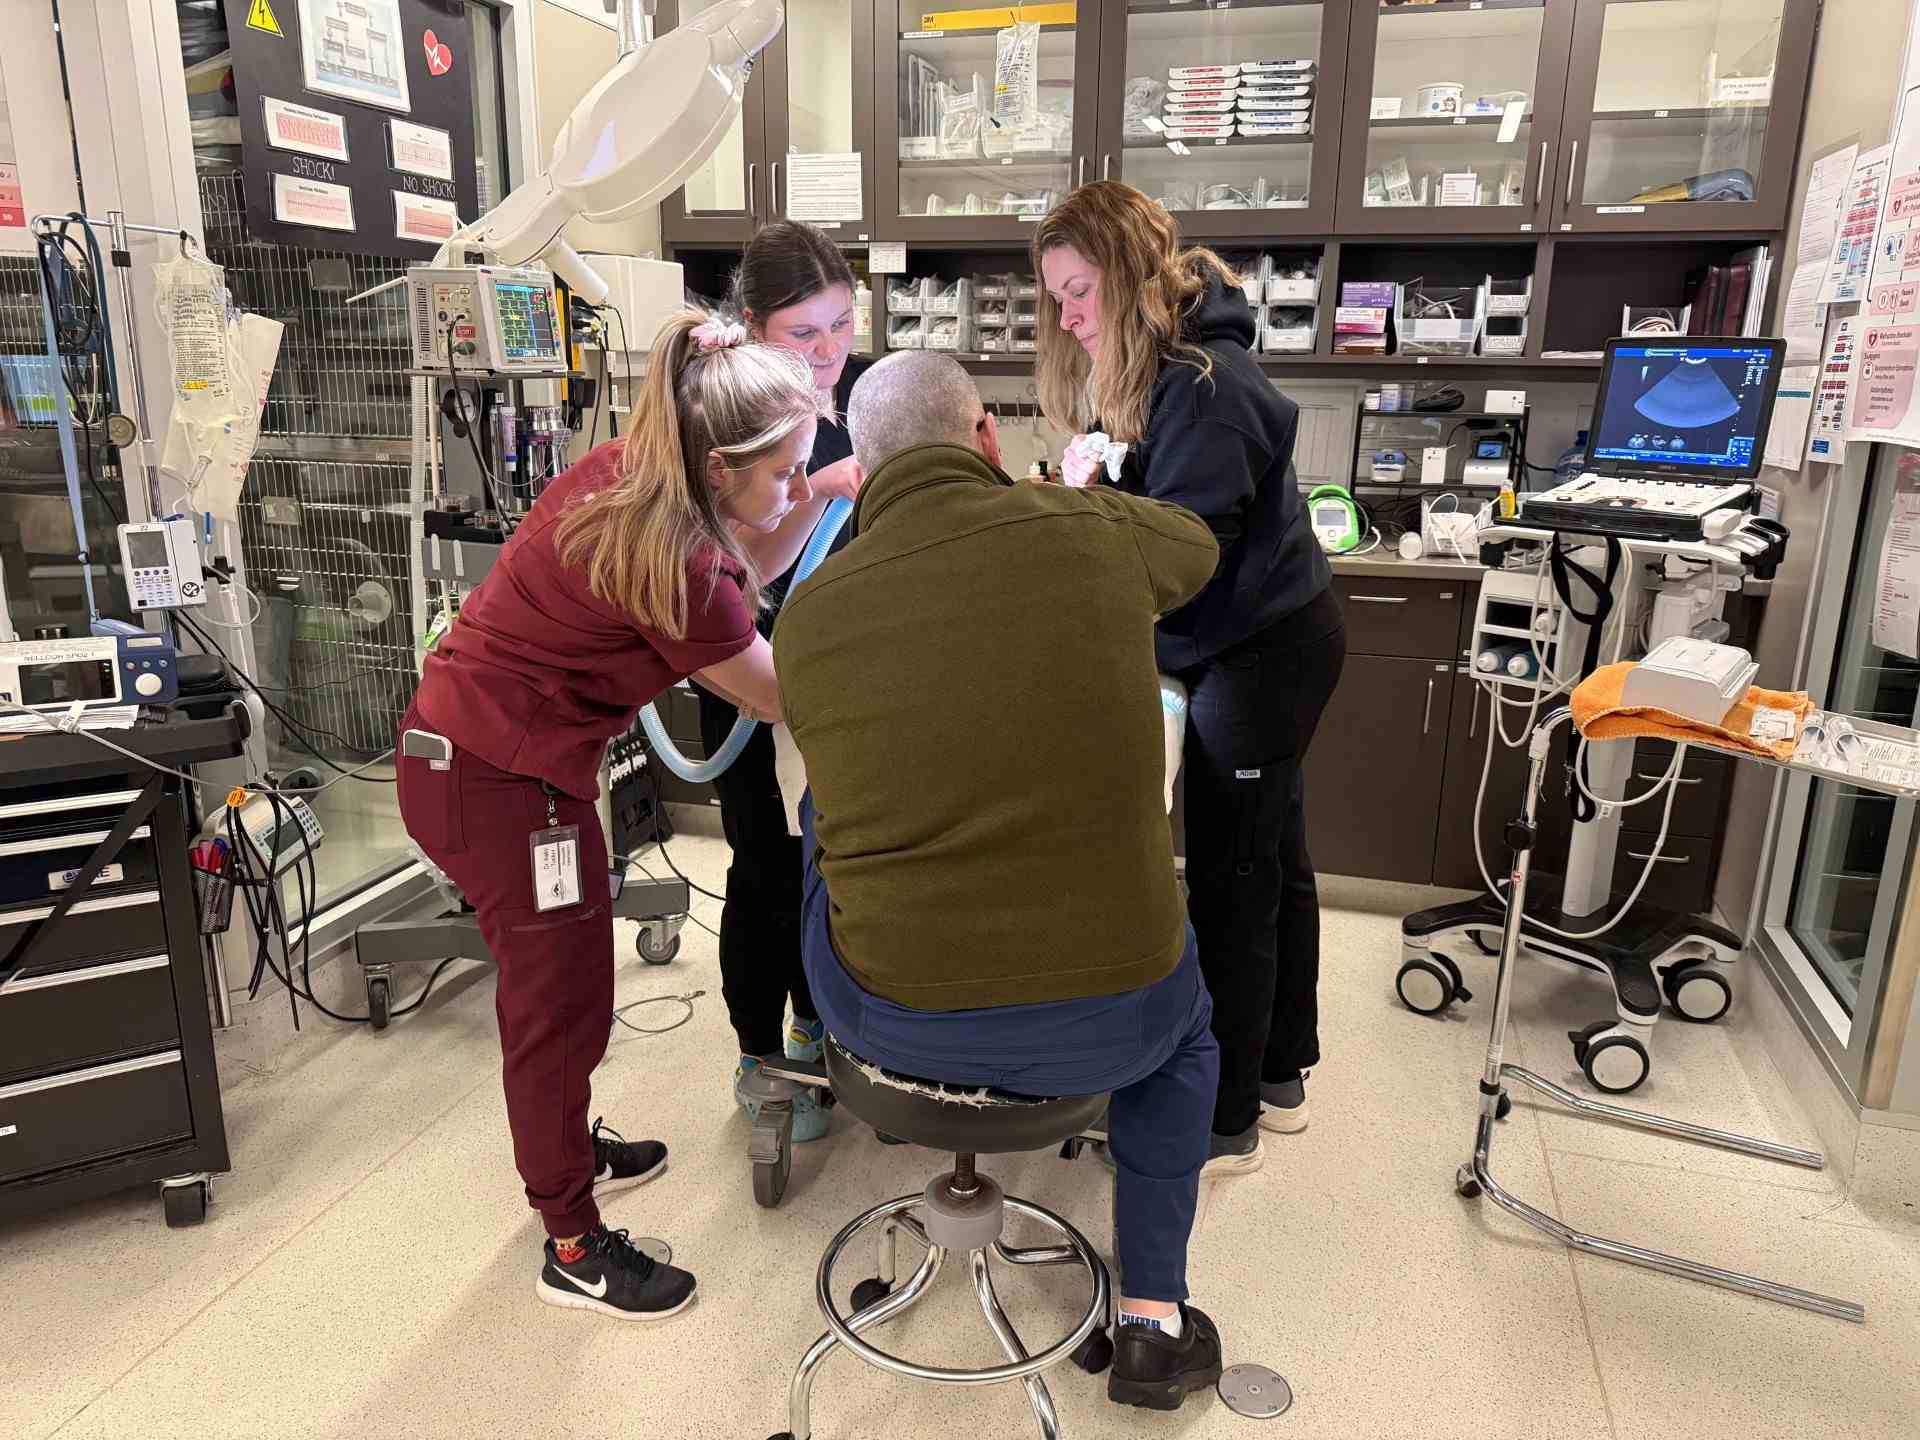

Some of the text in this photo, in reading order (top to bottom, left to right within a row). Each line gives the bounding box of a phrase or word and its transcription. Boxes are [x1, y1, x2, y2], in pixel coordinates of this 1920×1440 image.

[923, 16, 934, 24] 3M
[292, 156, 336, 181] SHOCK!
[403, 176, 456, 199] NO SHOCK!
